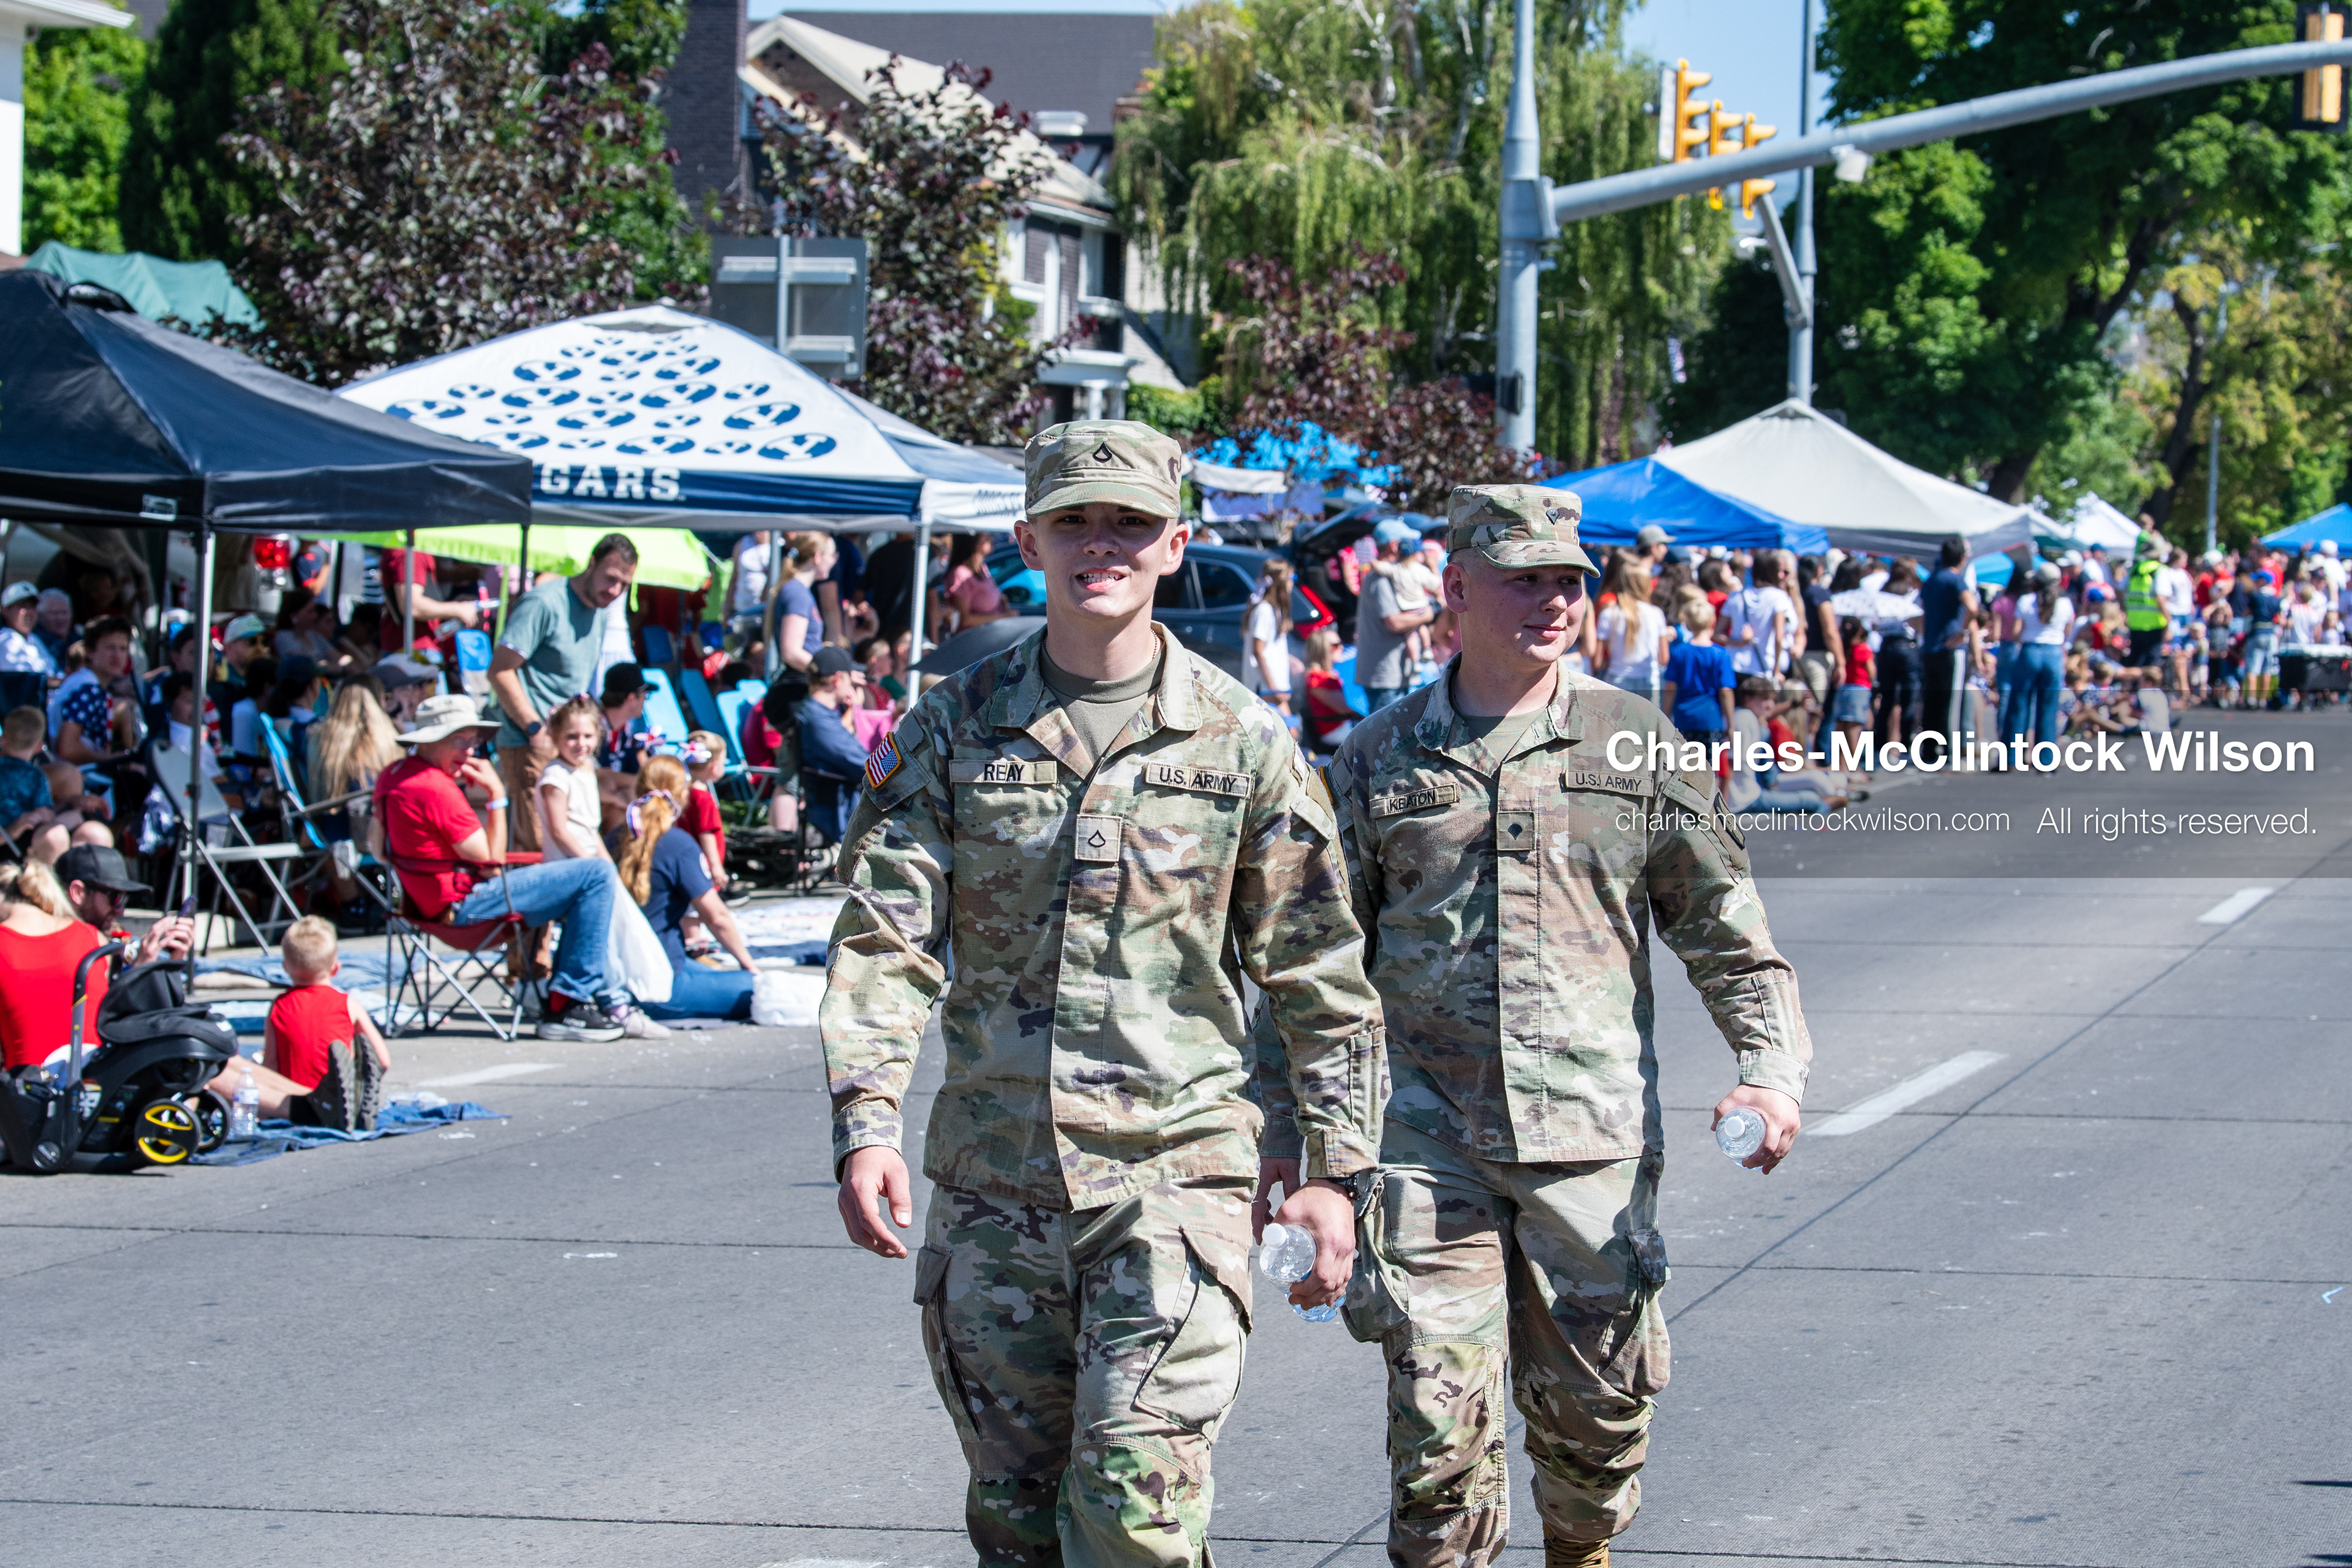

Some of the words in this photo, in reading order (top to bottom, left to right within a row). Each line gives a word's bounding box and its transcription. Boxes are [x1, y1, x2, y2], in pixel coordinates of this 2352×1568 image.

[536, 462, 681, 502] GARS
[984, 764, 1025, 781] REAY
[1159, 767, 1187, 785] U.S.
[1191, 773, 1237, 793] ARMY
[1575, 772, 1600, 786] U.S.
[1605, 775, 1642, 792] ARMY
[1389, 790, 1436, 811] KEATON
